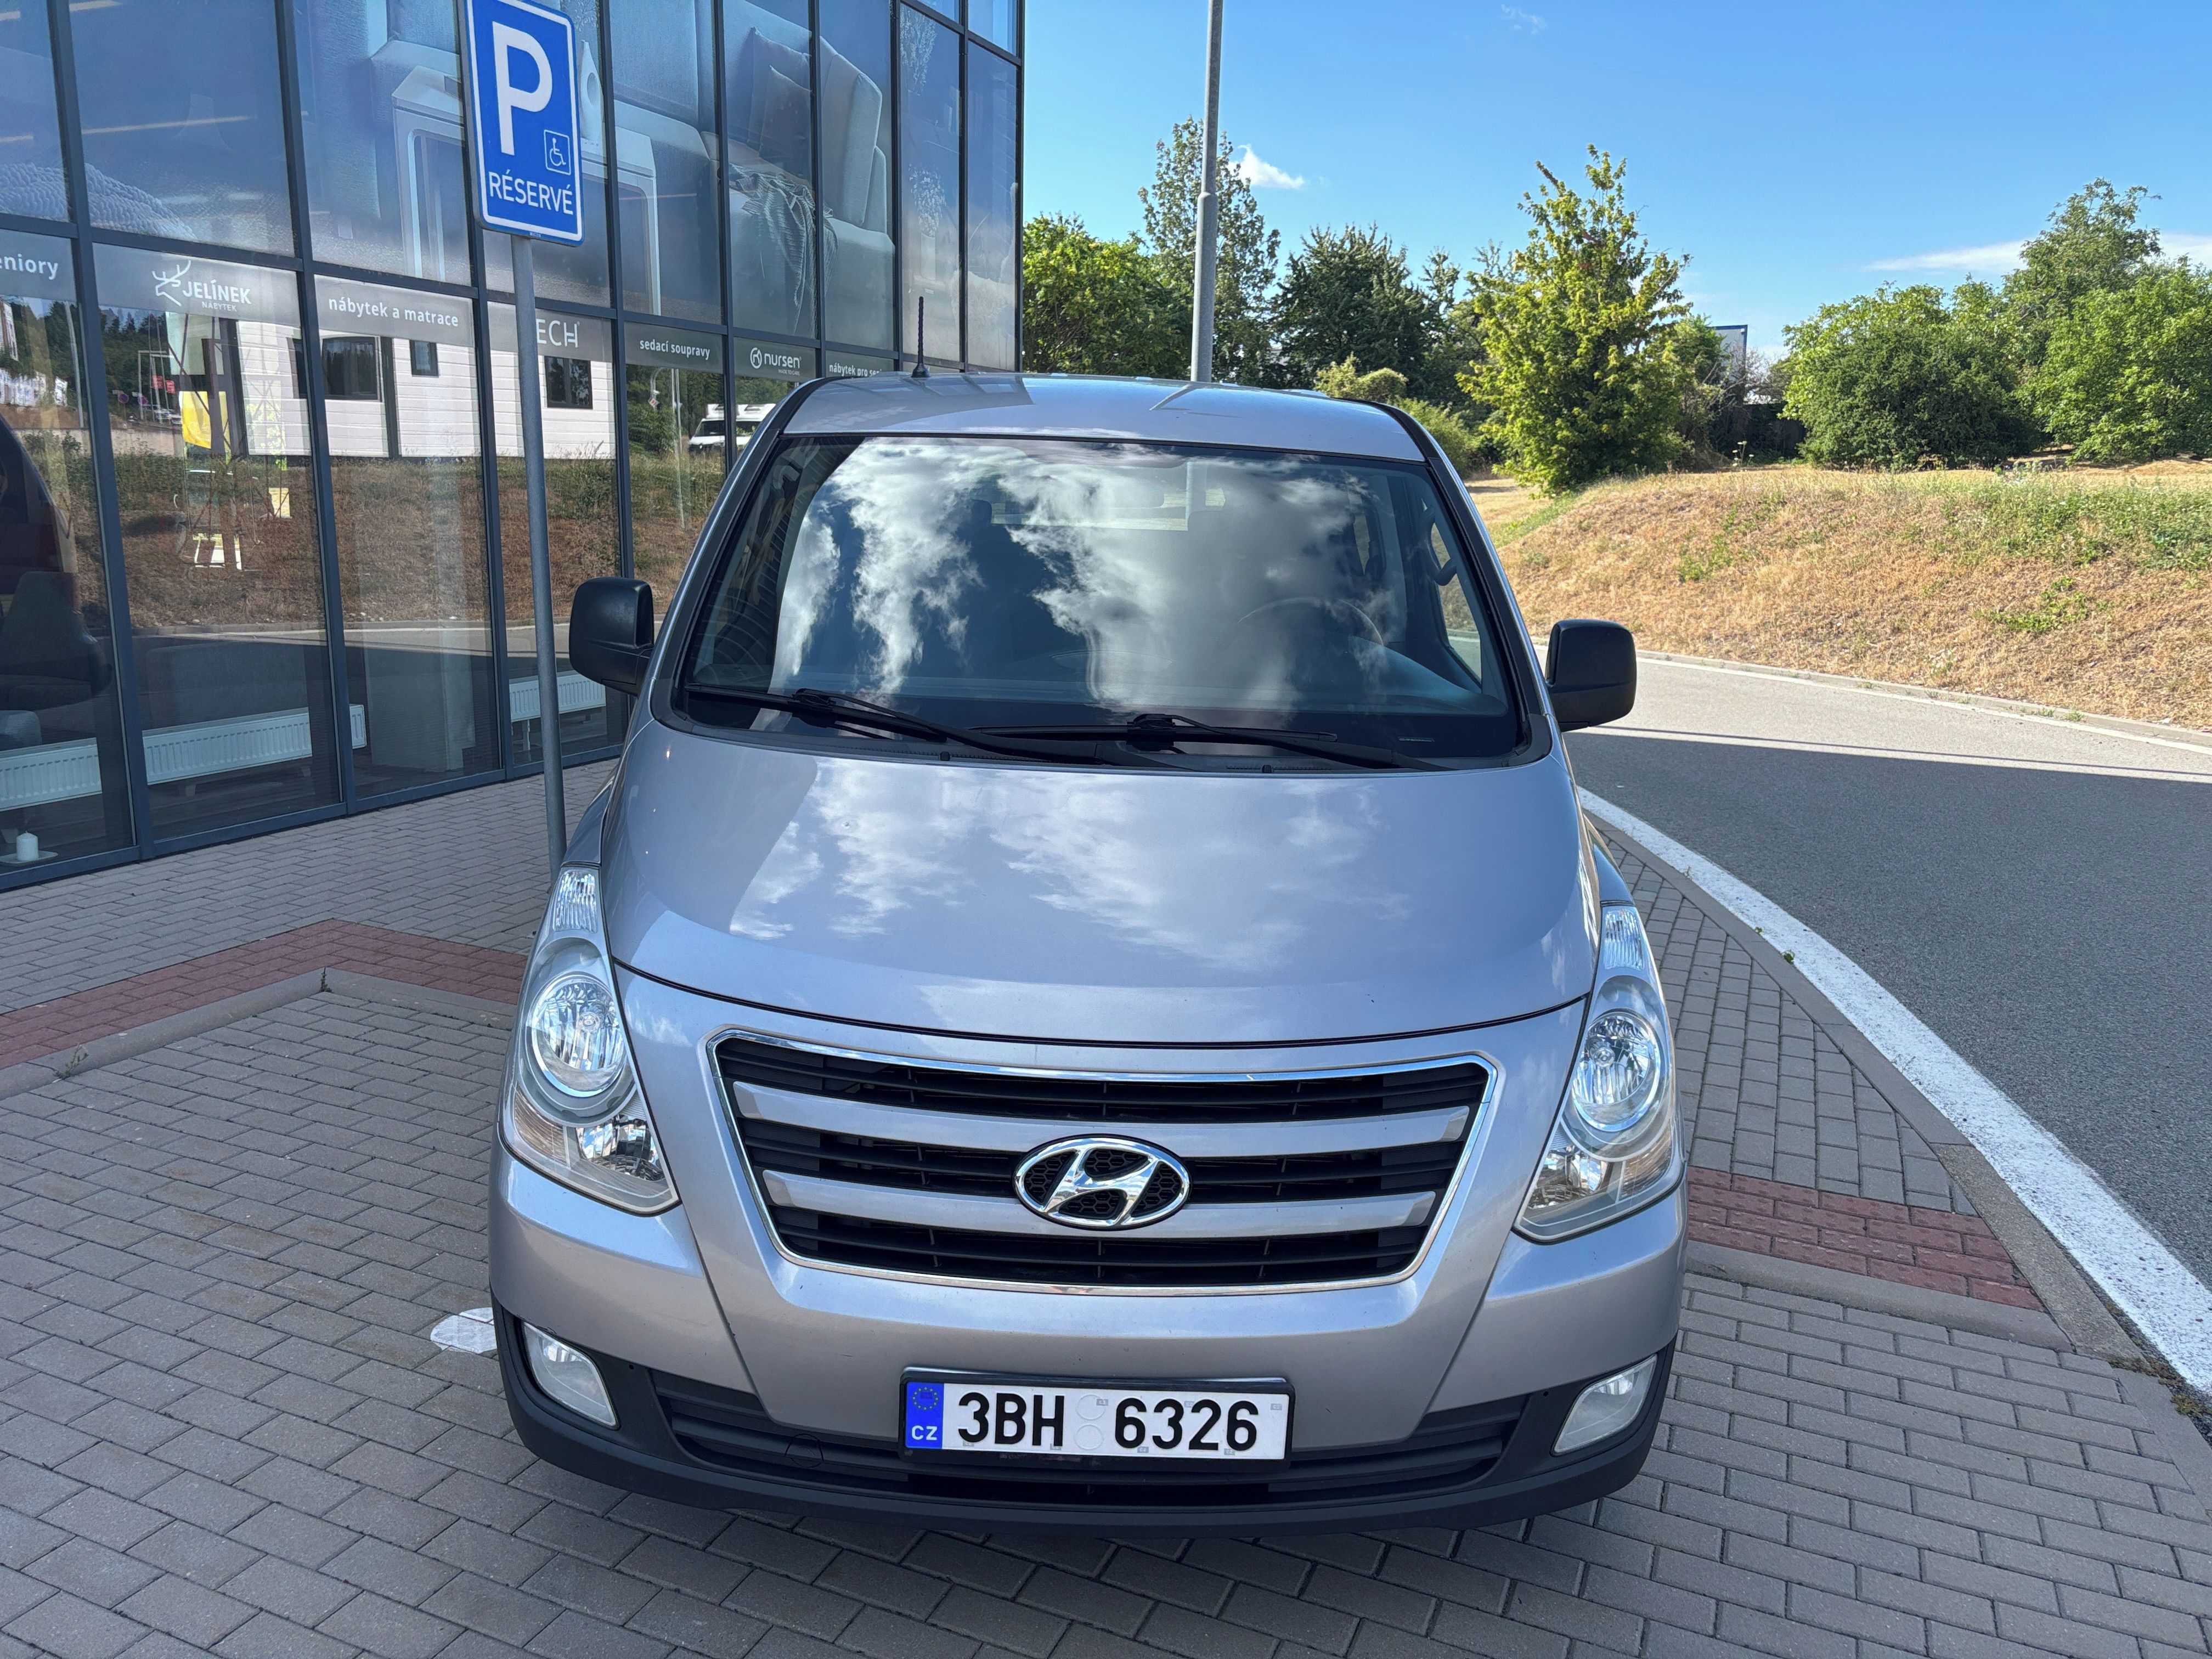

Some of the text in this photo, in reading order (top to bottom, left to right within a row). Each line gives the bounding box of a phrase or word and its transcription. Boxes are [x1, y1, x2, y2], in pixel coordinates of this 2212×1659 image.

[493, 21, 552, 156] P
[488, 169, 574, 216] RÉSERVÉ
[0, 253, 58, 280] niory
[182, 279, 252, 304] JELÍNEK
[202, 300, 237, 312] NÁBYTEK
[329, 297, 459, 327] nábytek a matrace
[640, 338, 710, 360] sedací soupravy
[764, 353, 800, 369] nursen
[829, 362, 856, 377] nábytek
[857, 368, 868, 377] pro
[911, 1425, 938, 1441] CZ
[958, 1392, 1259, 1451] 3BH 6326
